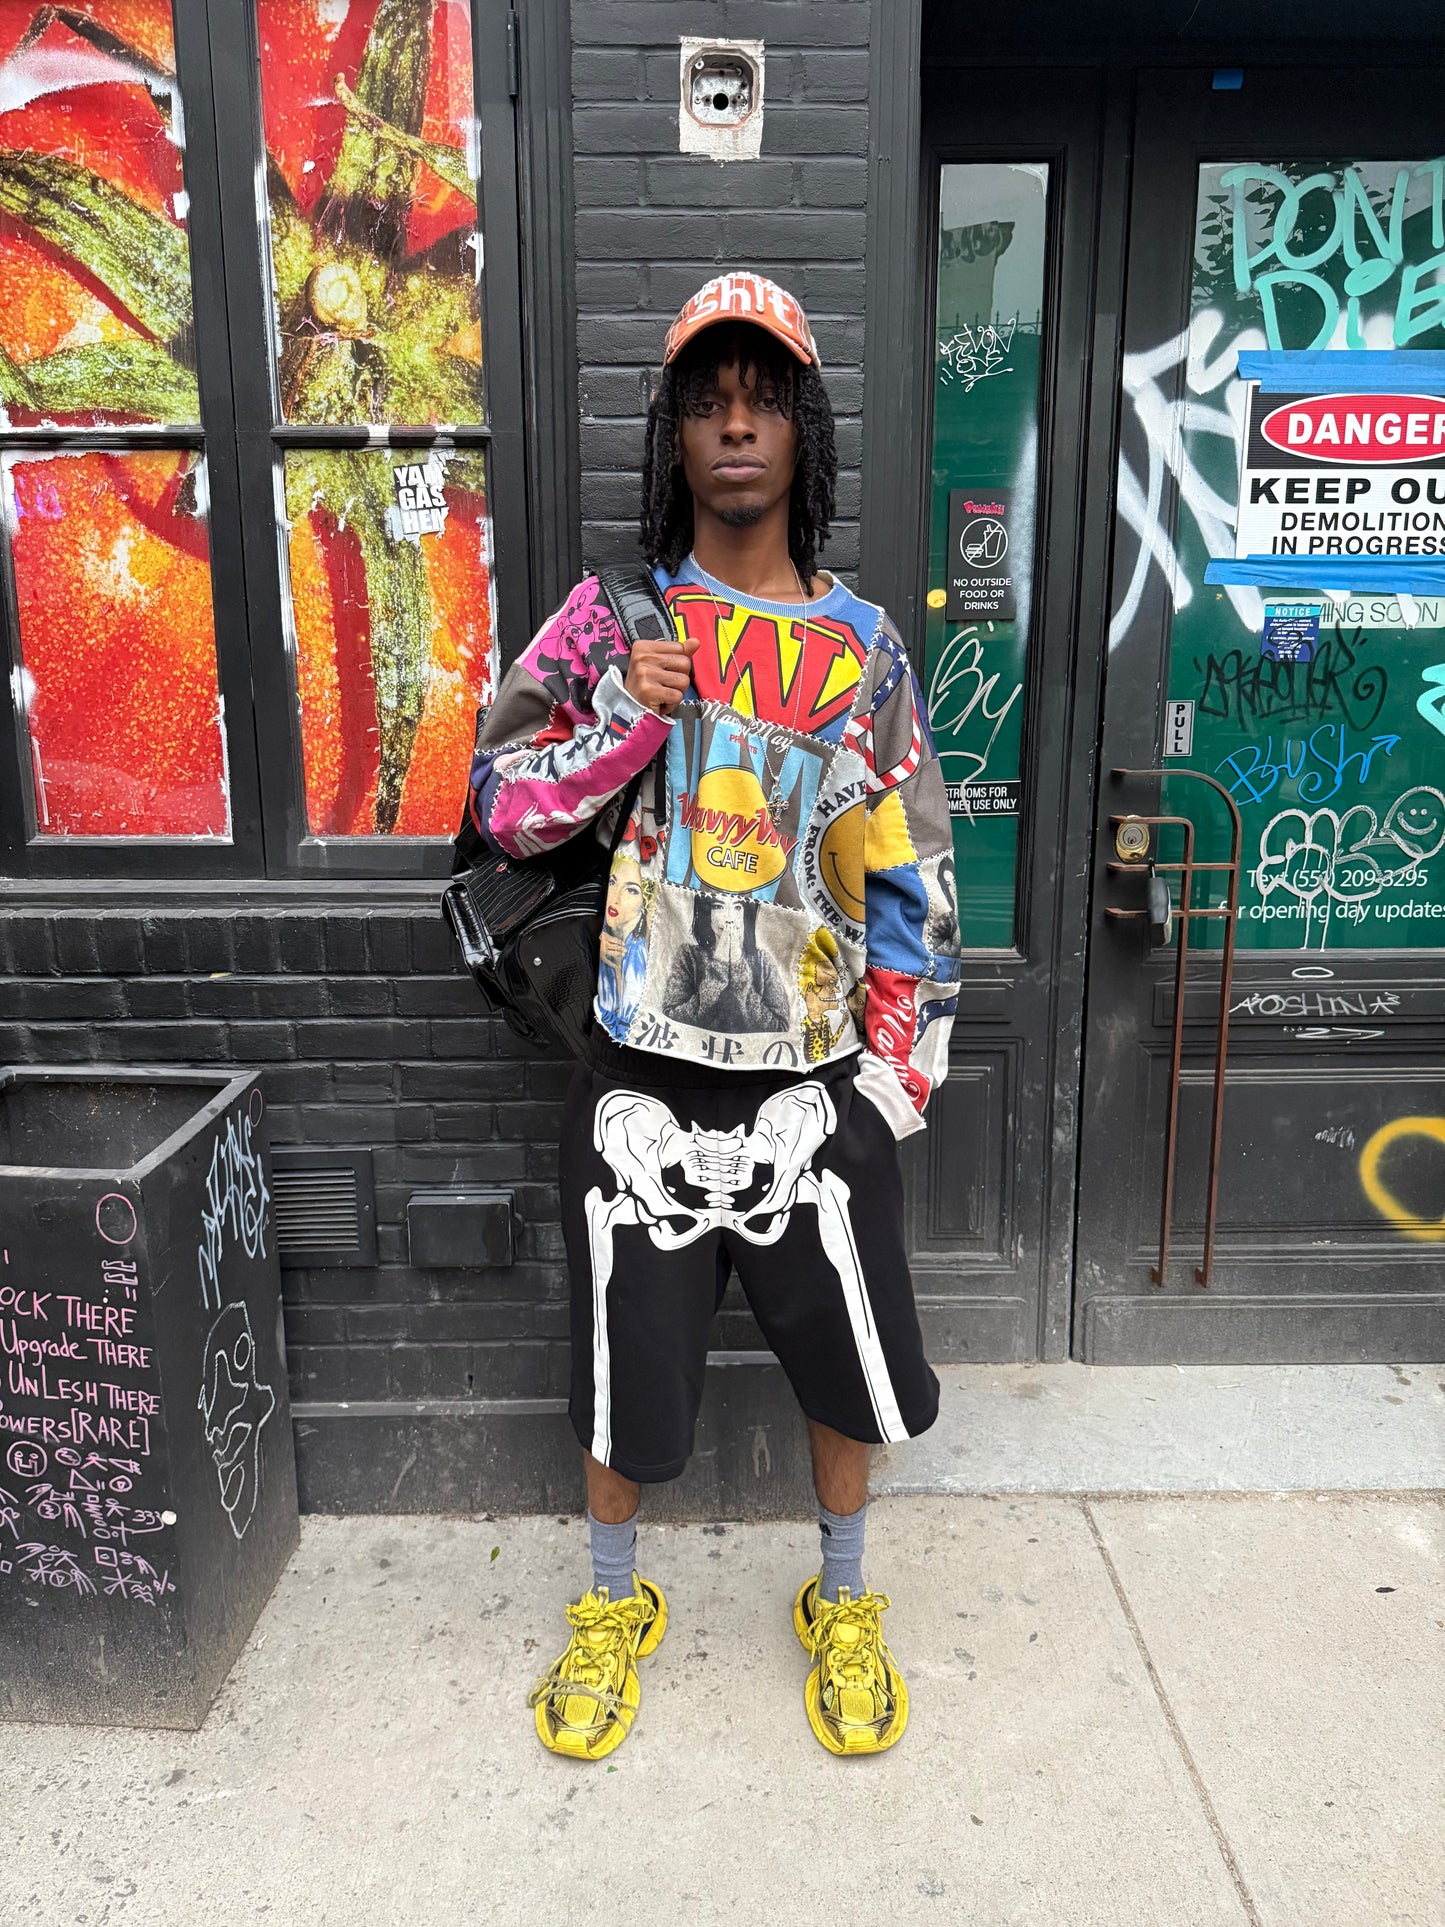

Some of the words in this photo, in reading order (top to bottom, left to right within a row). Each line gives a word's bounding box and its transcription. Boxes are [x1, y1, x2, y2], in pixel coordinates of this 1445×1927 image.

[399, 485, 447, 510] GAS
[1250, 478, 1371, 504] KEEP
[1272, 536, 1297, 555] IN
[953, 578, 968, 587] NO
[970, 577, 1012, 587] OUTSIDE
[959, 590, 988, 599] FOOD
[990, 589, 1005, 598] OR
[964, 601, 999, 610] DRINKS
[1275, 607, 1311, 617] NOTICE
[673, 599, 847, 734] W
[1174, 704, 1186, 753] PULL
[973, 799, 991, 810] USE
[993, 798, 1017, 810] ONLY
[989, 786, 1008, 798] FOR
[707, 846, 758, 874] CAFE
[812, 889, 842, 926] THE
[1249, 900, 1330, 924] opening
[1335, 899, 1371, 924] day
[0, 1287, 52, 1321] OCK
[56, 1295, 138, 1338] THERE
[0, 1318, 88, 1366] Upgrade
[86, 1337, 153, 1369] THERE
[100, 1382, 161, 1416] THERE
